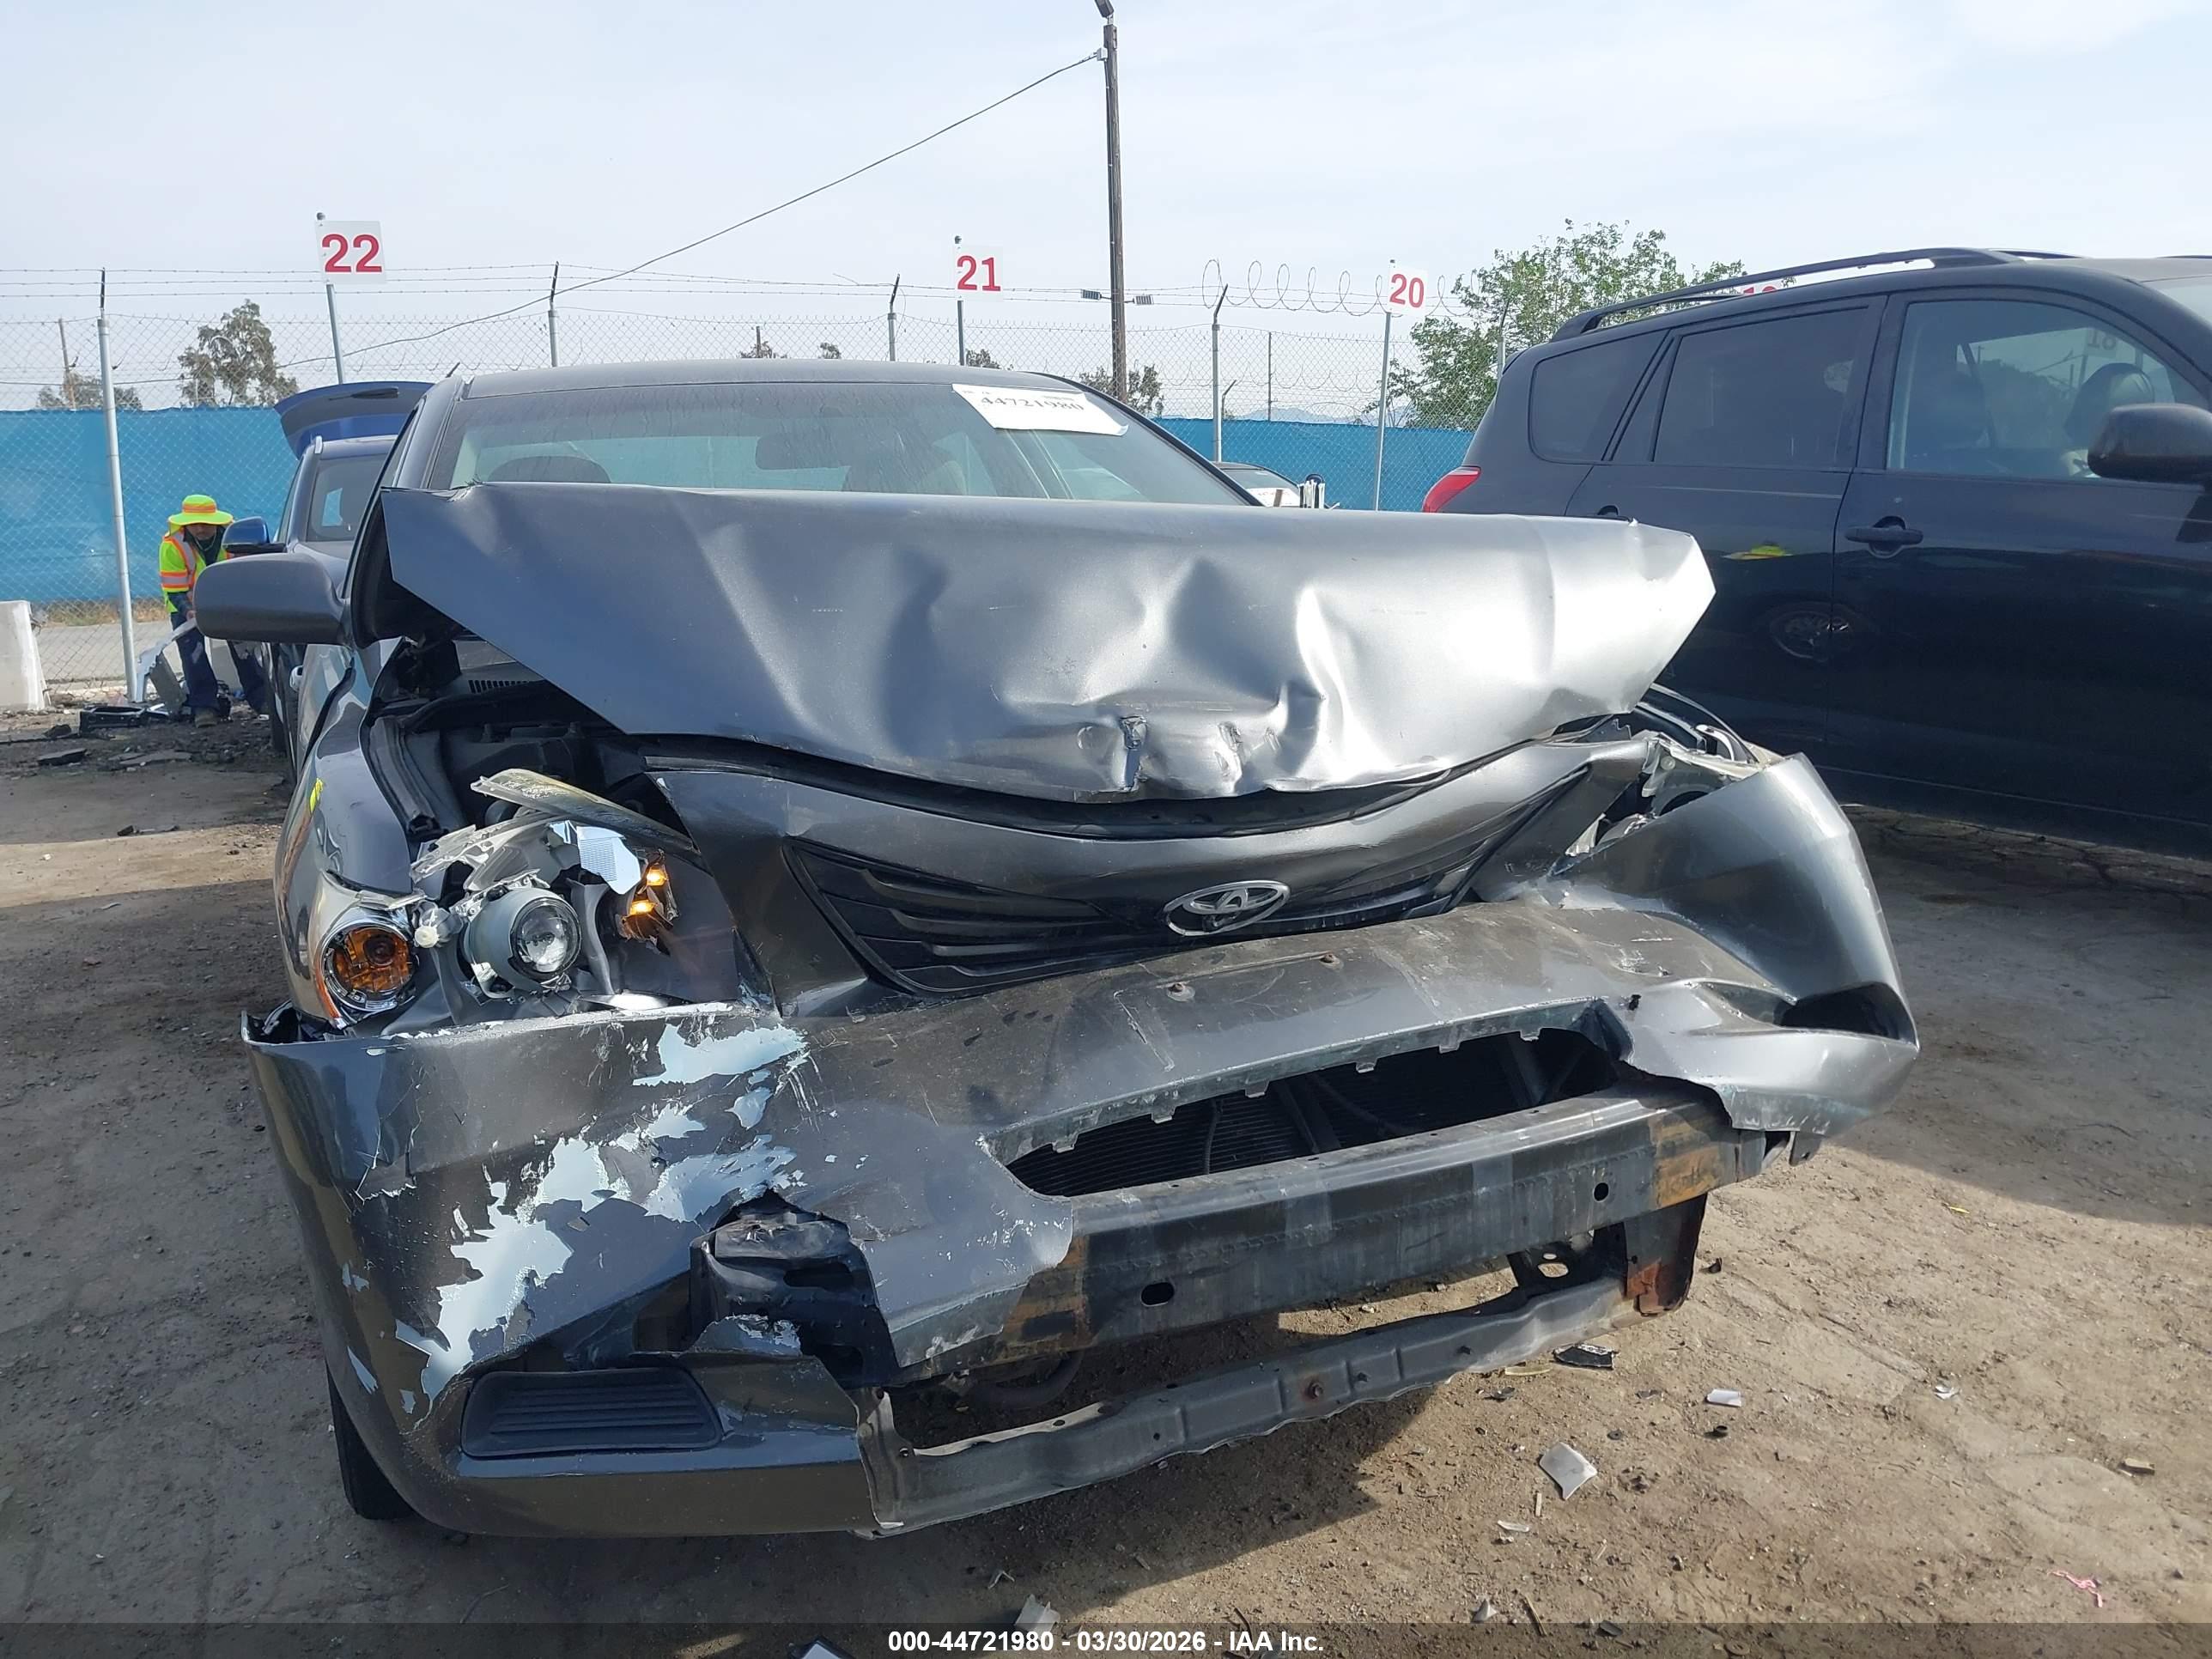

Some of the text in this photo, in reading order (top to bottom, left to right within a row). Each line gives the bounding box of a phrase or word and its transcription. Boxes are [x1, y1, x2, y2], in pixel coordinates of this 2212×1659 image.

[322, 234, 382, 273] 22
[957, 255, 1001, 292] 21
[1389, 273, 1425, 308] 20
